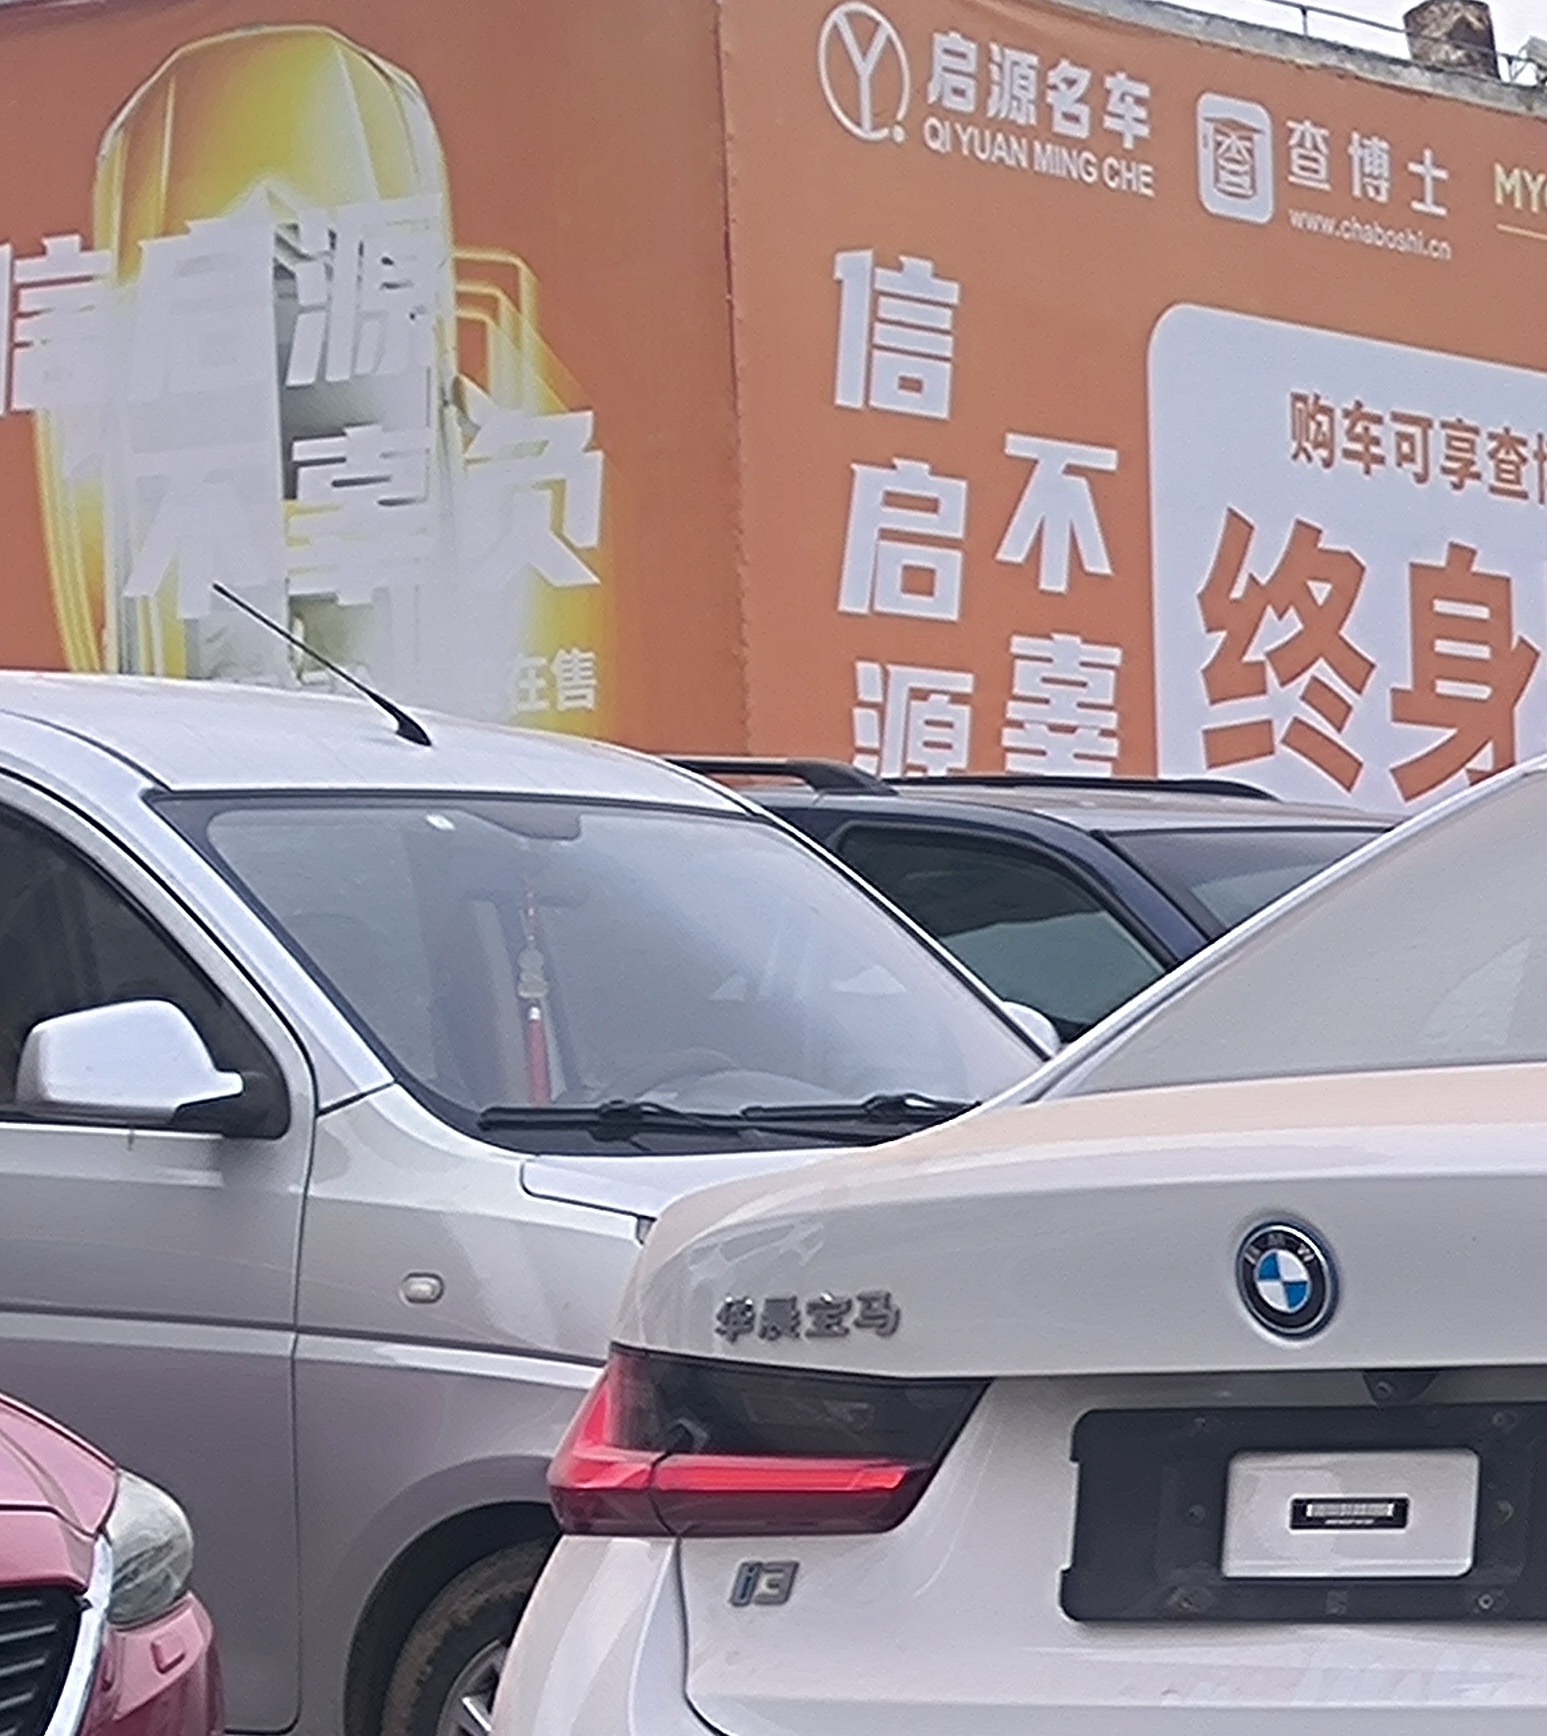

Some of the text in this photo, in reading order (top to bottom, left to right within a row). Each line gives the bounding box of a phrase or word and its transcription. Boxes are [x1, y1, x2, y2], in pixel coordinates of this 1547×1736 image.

[927, 32, 1151, 150] 启源名车
[922, 116, 1156, 199] QI YUAN MING CHE
[1286, 118, 1450, 218] 查博士
[1287, 207, 1452, 261] www.chaboshi.cn
[1197, 506, 1541, 802] 终身
[727, 1560, 800, 1608] i3
